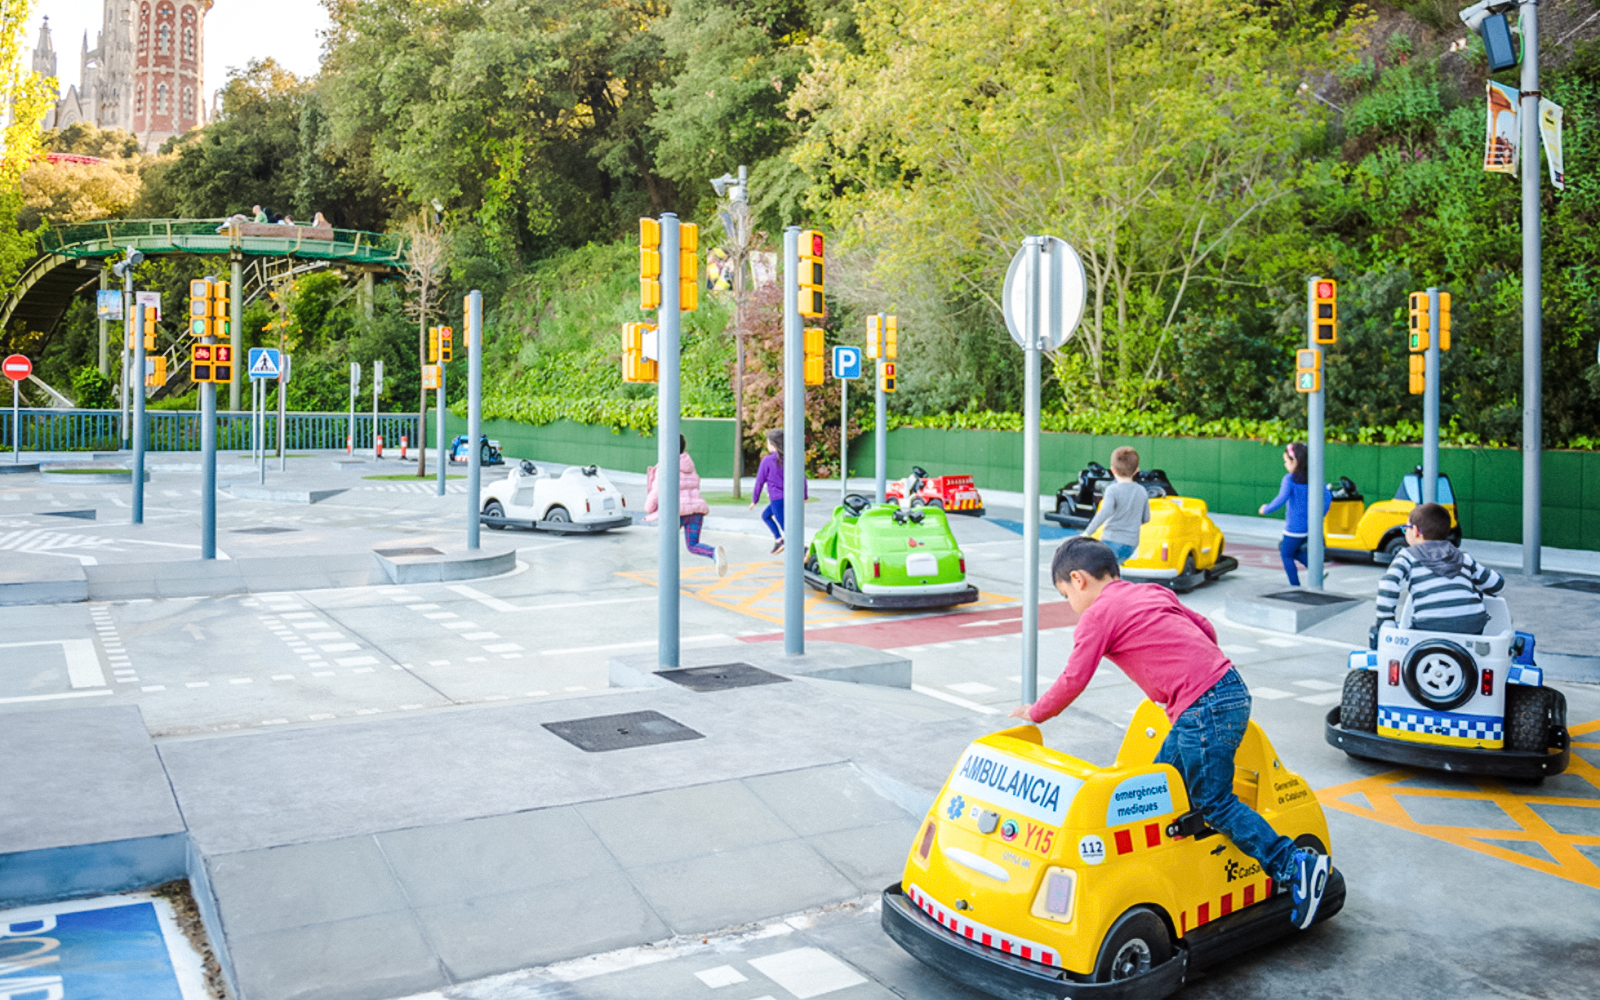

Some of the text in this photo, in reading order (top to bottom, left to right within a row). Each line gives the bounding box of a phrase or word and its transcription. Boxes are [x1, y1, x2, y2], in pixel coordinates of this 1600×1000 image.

[839, 350, 856, 376] P
[960, 755, 1060, 812] AMBULANCIA
[1024, 823, 1054, 854] Y15
[1081, 841, 1103, 853] 112
